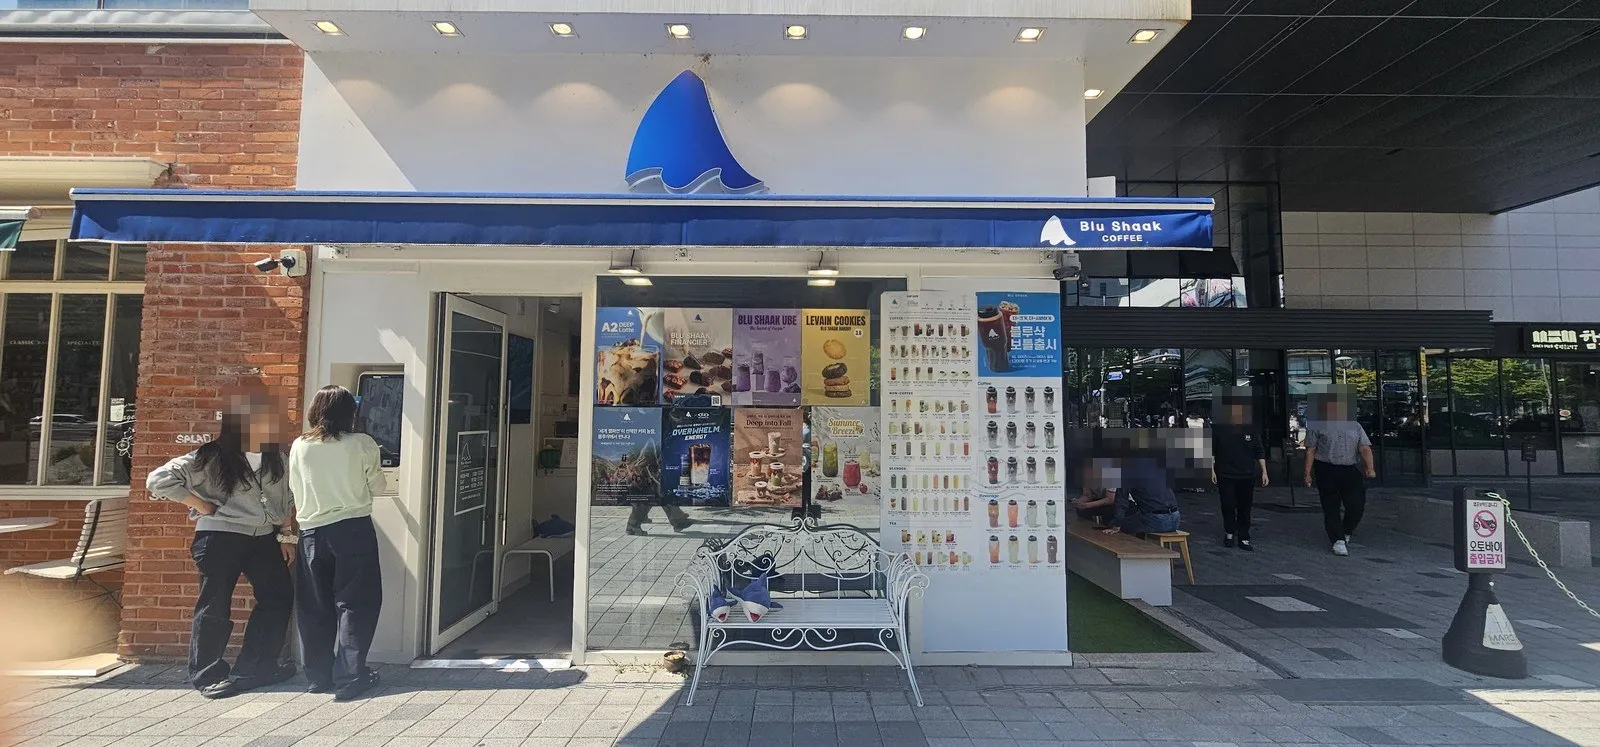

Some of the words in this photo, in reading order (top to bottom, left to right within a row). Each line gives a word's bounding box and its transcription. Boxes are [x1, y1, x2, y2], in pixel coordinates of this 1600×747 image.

[1080, 221, 1104, 231] Blu
[1112, 221, 1162, 231] Shaak
[1102, 234, 1143, 242] COFFEE
[738, 315, 753, 325] BLU
[754, 315, 780, 325] SHAAK
[782, 315, 797, 325] UBE
[806, 315, 832, 326] LEVAIN
[834, 316, 866, 326] COOKIES
[601, 322, 618, 333] A2
[1010, 325, 1046, 338] 블루샥
[1010, 338, 1057, 350] 보틀출시
[746, 419, 763, 427] Deep
[828, 417, 861, 427] Summer
[672, 426, 721, 436] OVERWHELM
[831, 427, 856, 435] Breeze
[175, 433, 211, 444] SALAD
[1470, 540, 1503, 553] 오토바이
[1470, 553, 1504, 565] 출입금지
